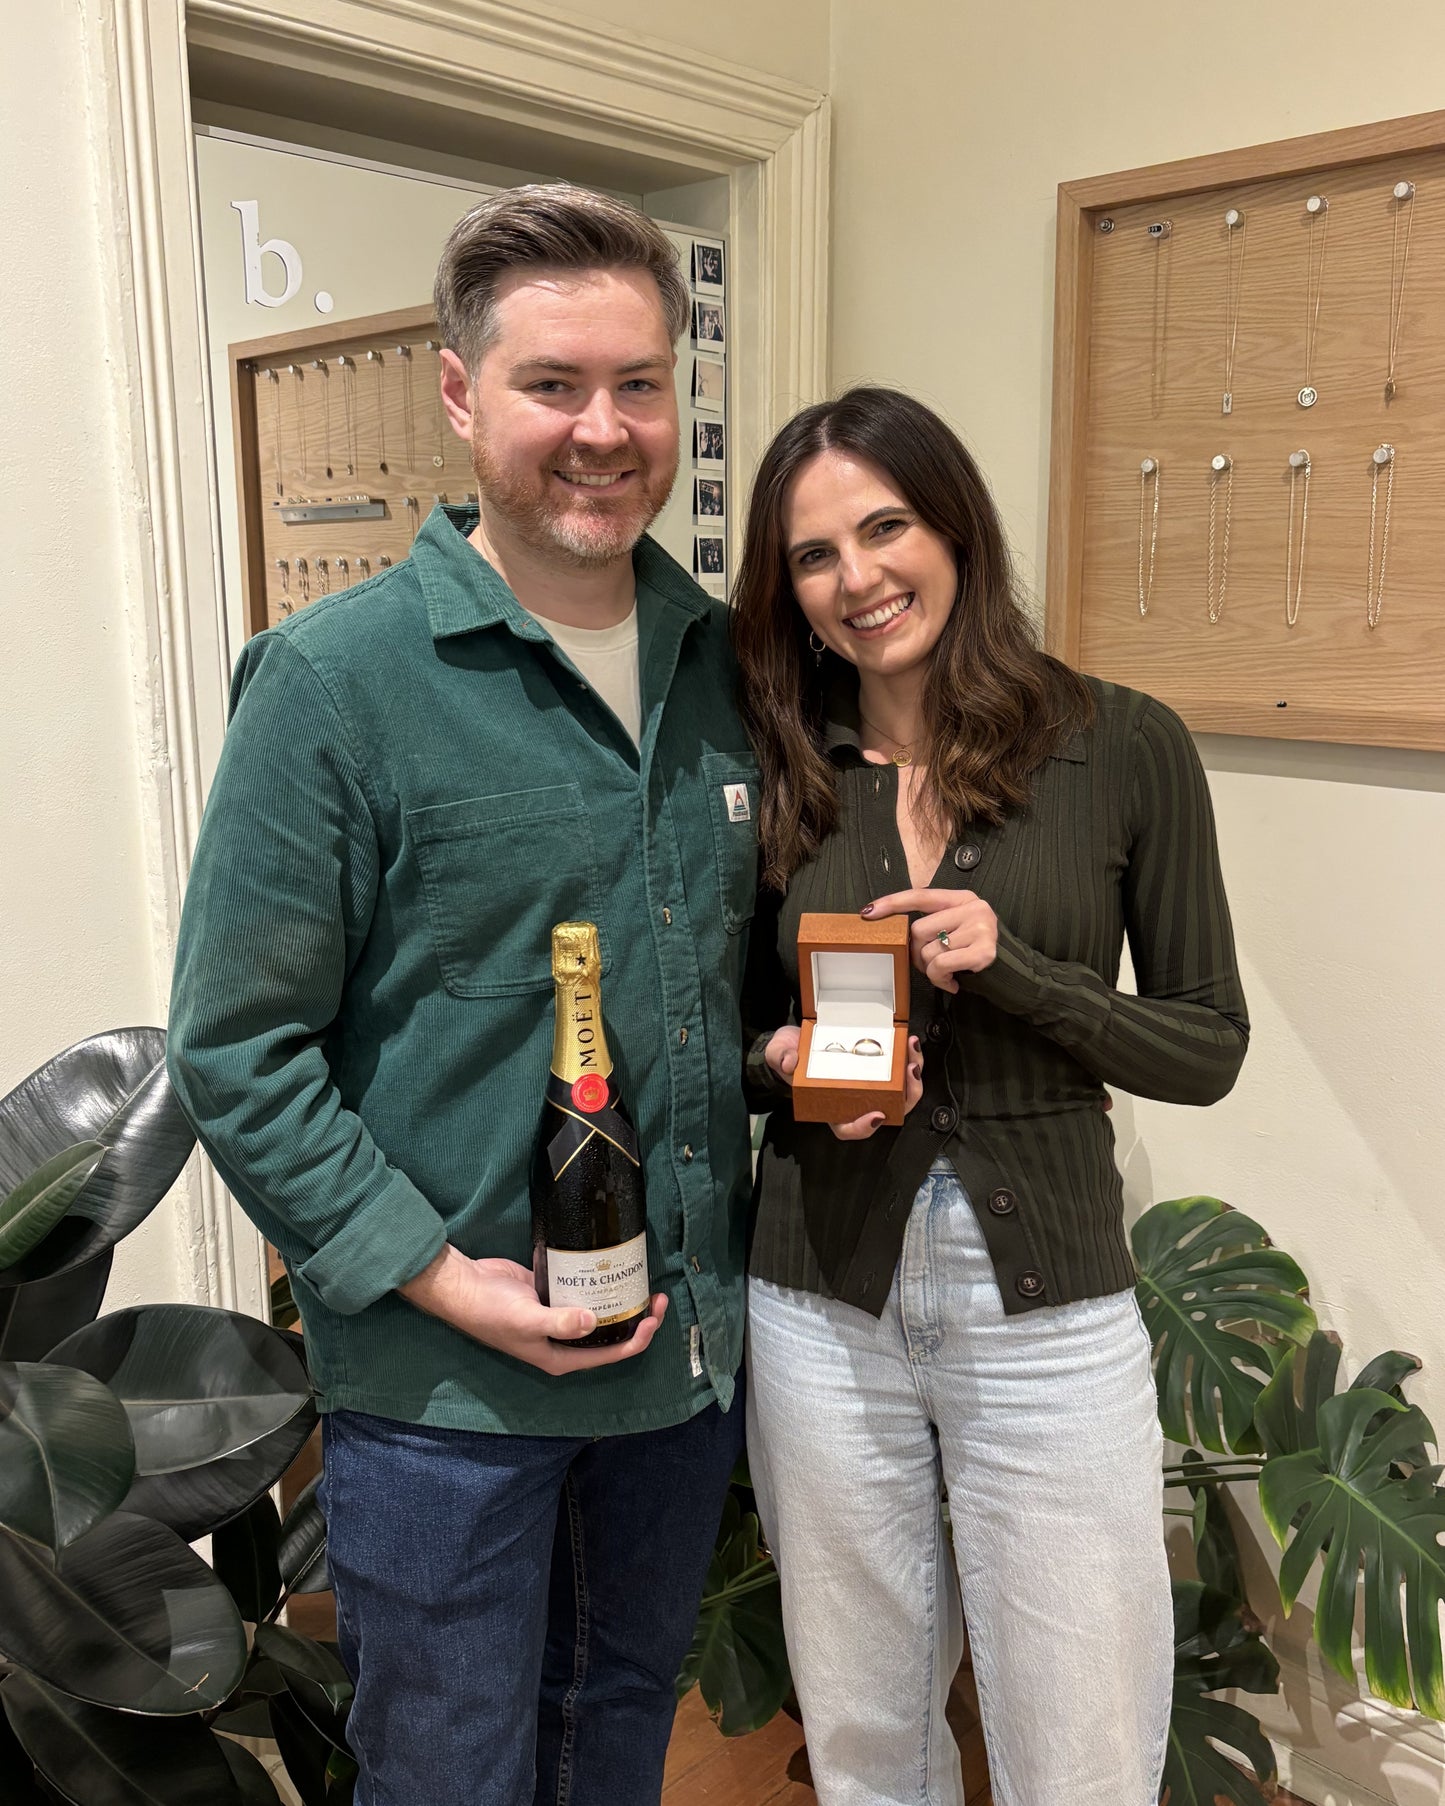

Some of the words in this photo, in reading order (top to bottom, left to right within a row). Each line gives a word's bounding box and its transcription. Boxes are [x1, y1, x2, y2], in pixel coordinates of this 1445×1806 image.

[230, 199, 334, 314] b.
[572, 991, 597, 1067] MOËT
[556, 1275, 587, 1287] MOËT
[589, 1276, 597, 1287] &
[599, 1260, 644, 1285] CHANDON
